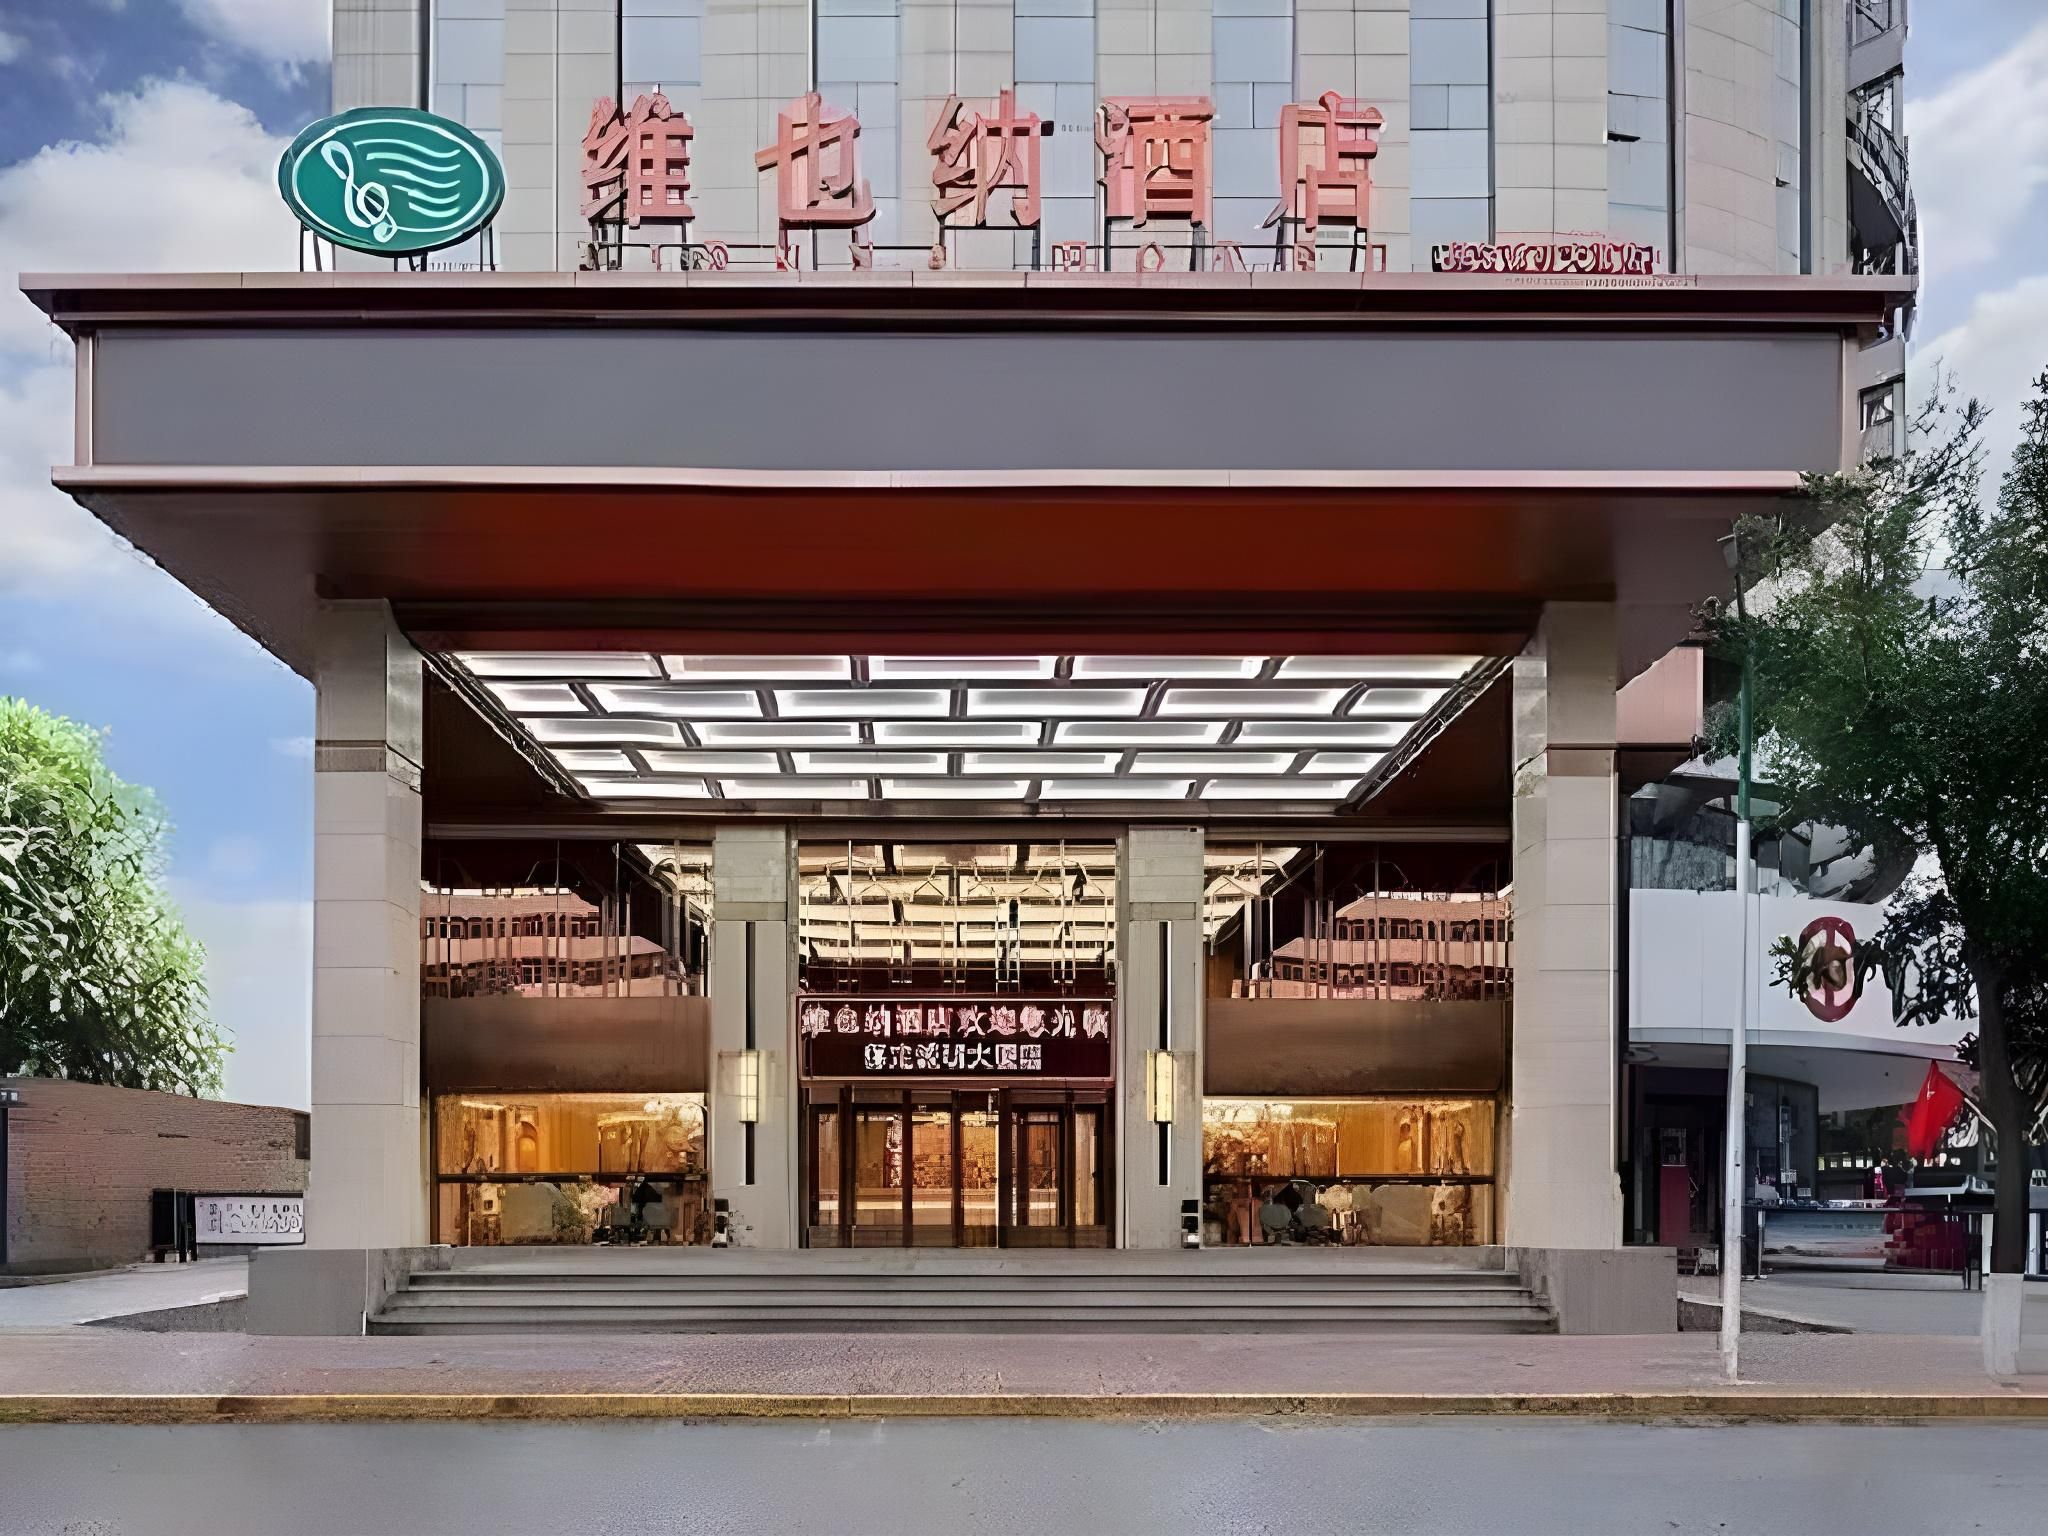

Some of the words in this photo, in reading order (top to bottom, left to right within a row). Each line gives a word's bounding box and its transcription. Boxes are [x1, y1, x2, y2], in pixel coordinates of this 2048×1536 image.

[581, 86, 1385, 228] 维也纳酒店
